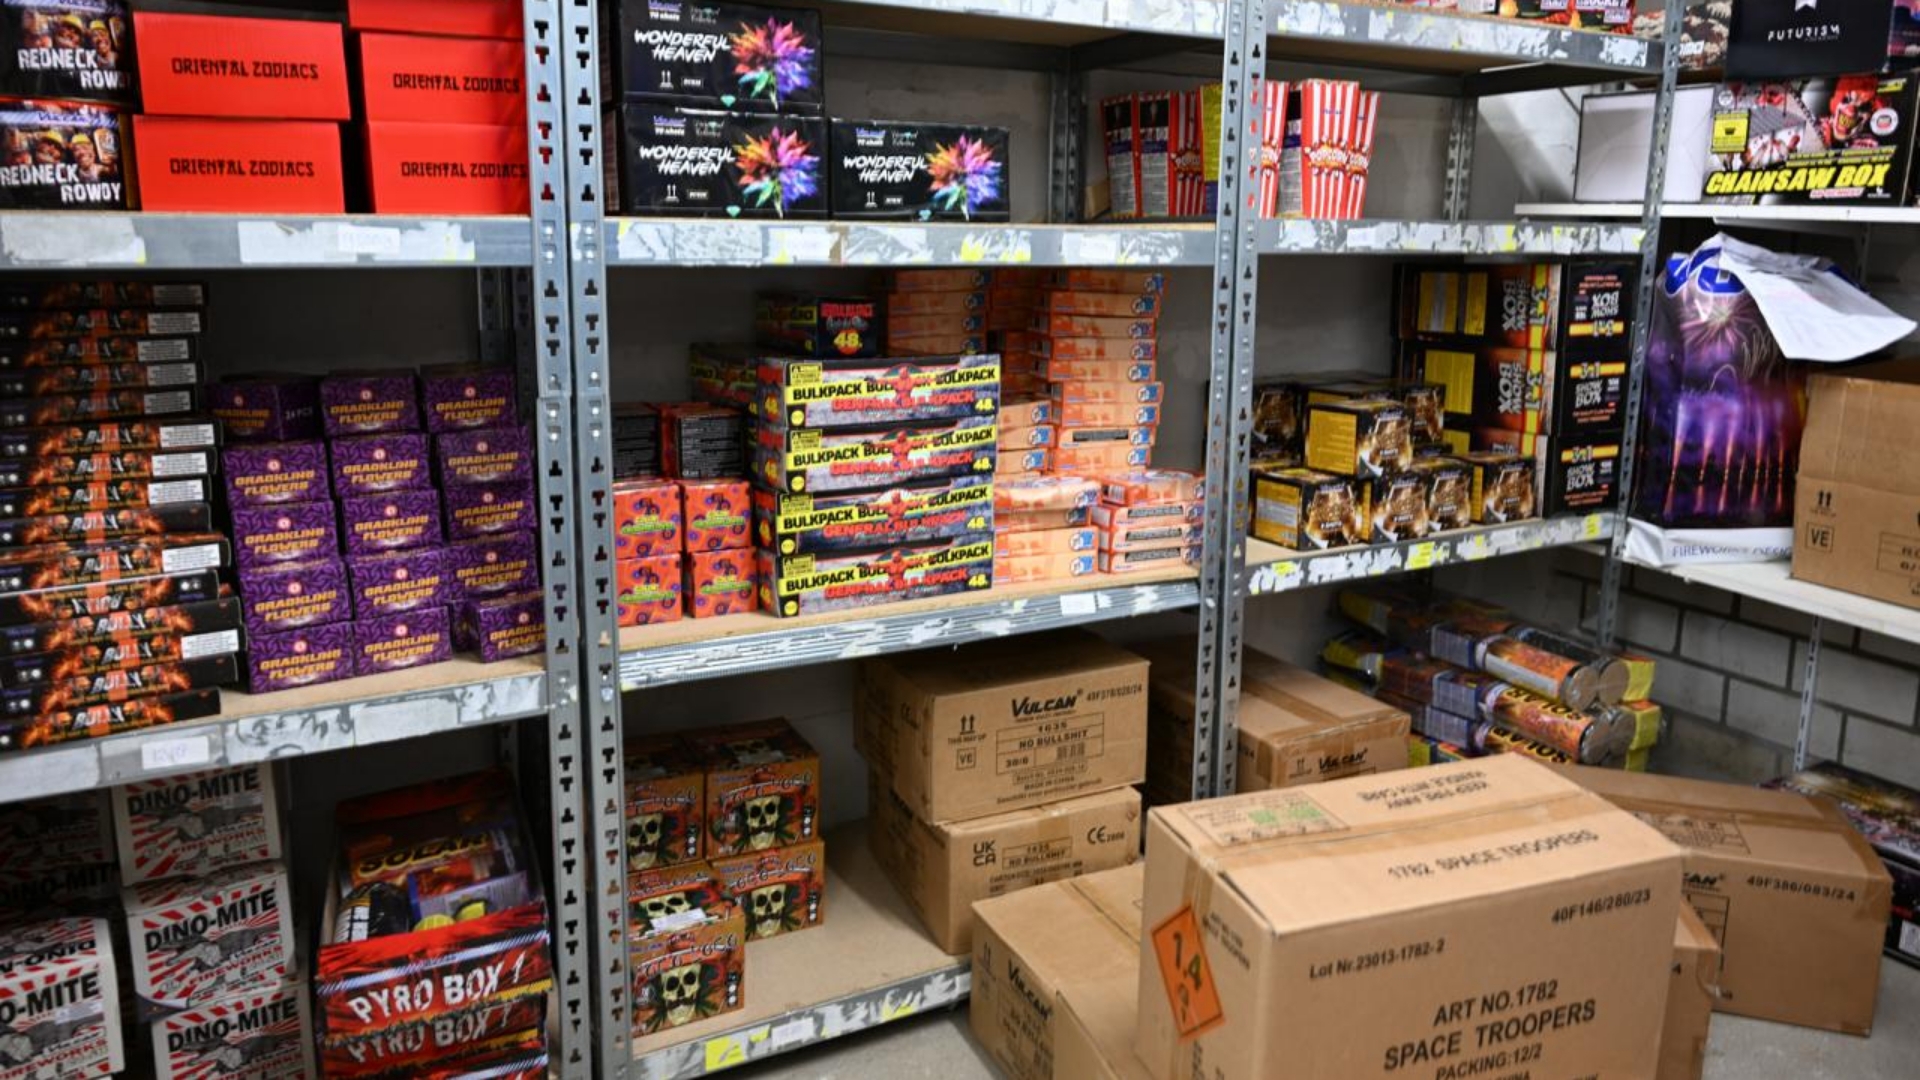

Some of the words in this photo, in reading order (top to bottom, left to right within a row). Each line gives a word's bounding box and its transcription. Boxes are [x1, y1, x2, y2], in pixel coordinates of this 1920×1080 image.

[634, 29, 731, 51] WONDERFUL
[1767, 24, 1840, 42] FUTURISM
[18, 48, 99, 70] REDNECK
[651, 45, 717, 63] HEAVEN
[172, 57, 248, 78] ORIENTAL
[253, 61, 319, 80] ZODIACS
[393, 73, 460, 91] ORIENTAL
[463, 77, 520, 93] ZODIACS
[640, 144, 736, 163] WONDERFUL
[843, 153, 928, 170] WONDERFUL
[0, 164, 79, 185] REDNECK
[170, 158, 245, 176] ORIENTAL
[249, 160, 315, 178] ZODIACS
[401, 161, 467, 178] ORIENTAL
[470, 163, 528, 179] ZODIACS
[657, 159, 722, 177] HEAVEN
[859, 167, 915, 184] HEAVEN
[1706, 166, 1836, 195] CHAINSAW
[1835, 163, 1891, 189] BOX
[61, 182, 121, 202] ROWDY
[793, 382, 861, 400] BULKPACK
[1498, 363, 1513, 414] BOX
[1575, 392, 1602, 409] BOX
[339, 411, 398, 424] FLOWERS
[444, 408, 499, 419] FLOWERS
[793, 446, 859, 466] BULKPACK
[352, 470, 411, 484] FLOWERS
[456, 462, 513, 475] FLOWERS
[244, 482, 308, 495] FLOWERS
[1566, 473, 1595, 491] BOX
[462, 511, 518, 526] FLOWERS
[783, 508, 853, 529] BULKPACK
[363, 526, 422, 541] FLOWERS
[1811, 528, 1829, 547] VE
[254, 539, 318, 554] FLOWERS
[465, 570, 521, 586] FLOWERS
[786, 568, 855, 592] BULKPACK
[373, 588, 434, 605] FLOWERS
[265, 604, 332, 621] FLOWERS
[373, 645, 433, 662] FLOWERS
[269, 661, 335, 679] FLOWERS
[1012, 693, 1078, 717] VULCAN
[1019, 739, 1034, 749] NO
[1037, 730, 1088, 746] BULLSHIT
[128, 768, 260, 816] DINO-MITE
[1087, 826, 1107, 845] CE
[973, 840, 996, 856] UK
[1388, 861, 1435, 878] 1782
[1435, 848, 1503, 871] SPACE
[1501, 828, 1600, 858] TROOPERS
[973, 853, 996, 867] CA
[1551, 888, 1652, 924] 40F146/280/23
[144, 888, 277, 953] DINO-MITE
[1309, 961, 1334, 980] Lot
[347, 977, 434, 1024] PYRO
[443, 961, 504, 1006] BOX
[512, 950, 526, 983] 1
[1433, 998, 1477, 1027] ART
[1481, 979, 1559, 1015] NO.1782
[167, 998, 299, 1053] DINO-MITE
[435, 1009, 491, 1048] BOX
[1384, 1031, 1462, 1071] SPACE
[1475, 999, 1597, 1048] TROOPERS
